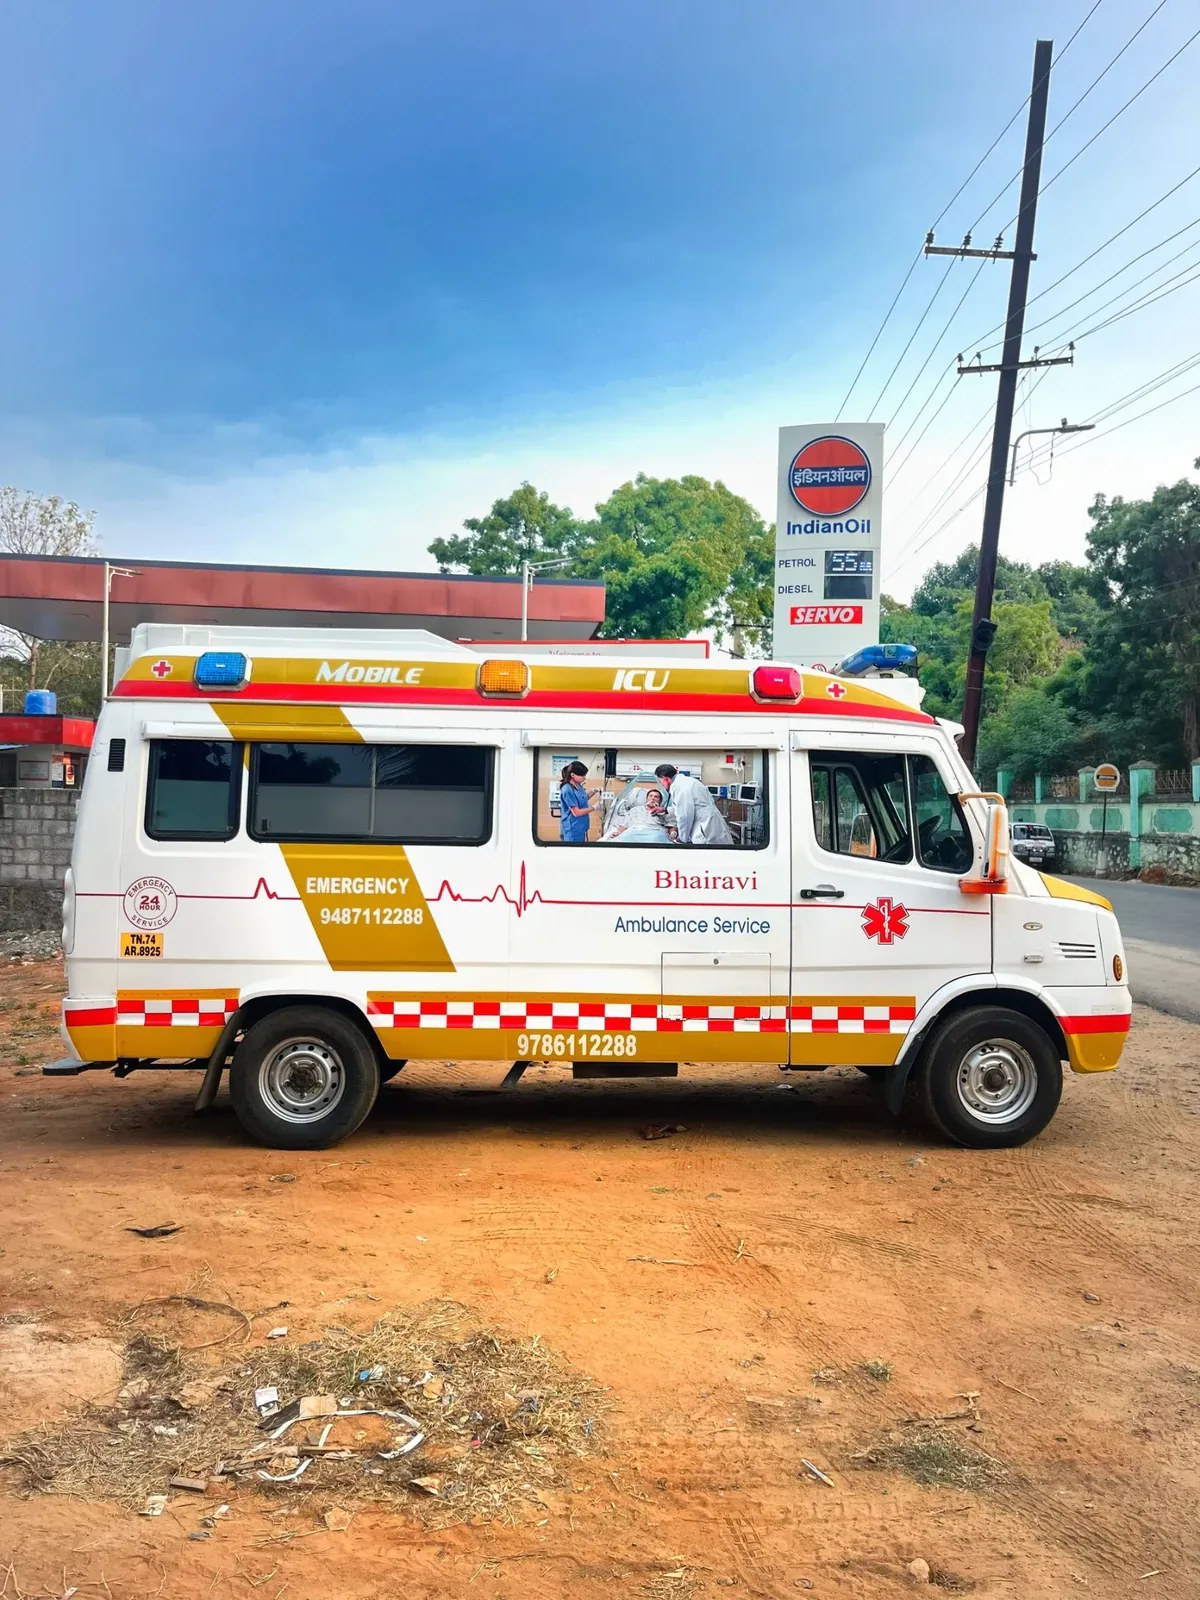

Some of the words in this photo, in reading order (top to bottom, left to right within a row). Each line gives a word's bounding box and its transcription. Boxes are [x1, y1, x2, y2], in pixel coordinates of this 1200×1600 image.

[794, 467, 866, 486] इंडियनऑयल
[787, 519, 871, 535] IndianOil
[779, 558, 816, 568] PETROL
[778, 584, 813, 594] DIESEL
[794, 607, 854, 623] SERVO
[315, 661, 424, 684] MOBILE
[612, 669, 670, 691] ICU
[305, 877, 409, 894] EMERGENCY
[654, 869, 758, 890] Bhairavi
[128, 879, 173, 898] EMERGENCY
[140, 895, 160, 905] 24
[131, 914, 169, 927] SERVICE
[320, 908, 423, 924] 9487112288
[614, 916, 708, 933] Ambulance
[713, 916, 770, 934] Service
[130, 934, 156, 944] TN.74
[124, 946, 161, 956] AR.8925
[517, 1034, 637, 1056] 9786112288
